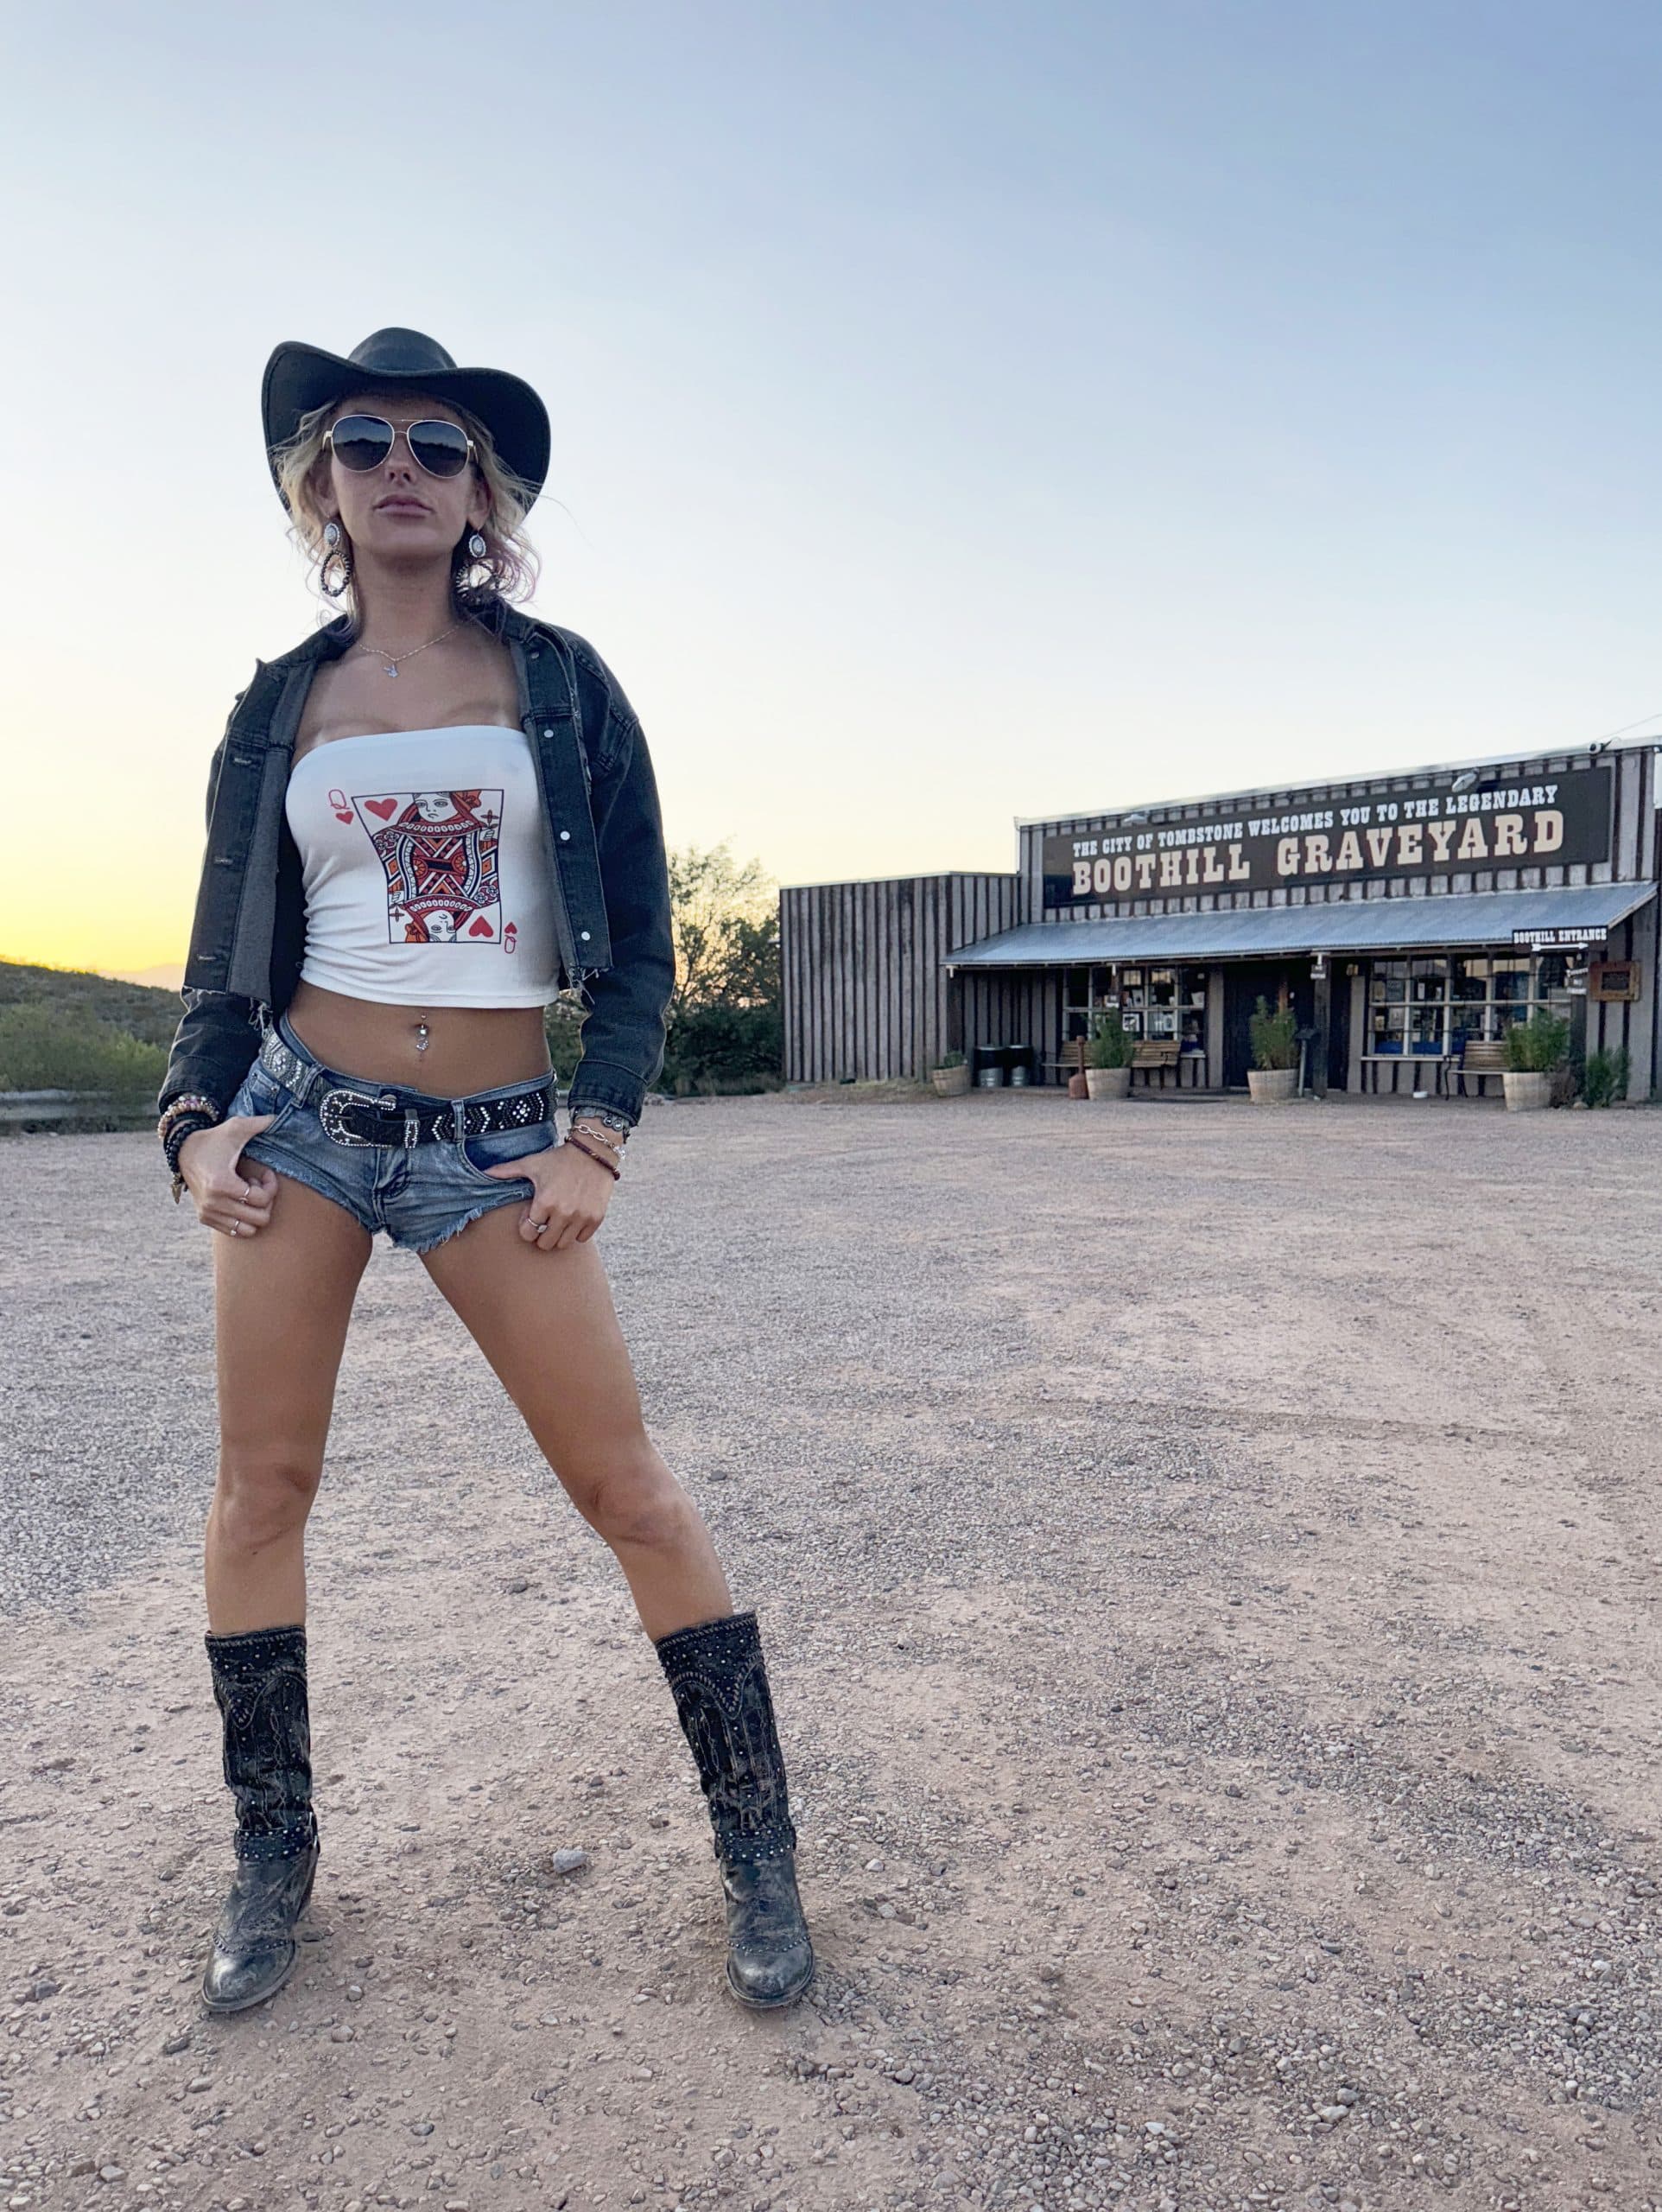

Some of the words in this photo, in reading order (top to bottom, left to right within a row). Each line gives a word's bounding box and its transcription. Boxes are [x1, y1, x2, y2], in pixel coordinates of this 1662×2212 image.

[328, 789, 350, 810] Q
[1073, 841, 1097, 857] THE
[1102, 836, 1132, 854] CITY
[1137, 834, 1153, 850] OF
[1158, 823, 1243, 848] TOMBSTONE
[1248, 810, 1334, 836] WELCOMES
[1340, 806, 1371, 826] YOU
[1377, 804, 1398, 822] TO
[1404, 798, 1439, 819] THE
[1446, 785, 1557, 815] LEGENDARY
[1073, 844, 1250, 895] BOOTHILL
[1277, 810, 1564, 876] GRAVEYARD
[504, 935, 517, 954] Q
[1513, 931, 1556, 944] BOOTHILL
[1558, 928, 1607, 942] ENTRANCE
